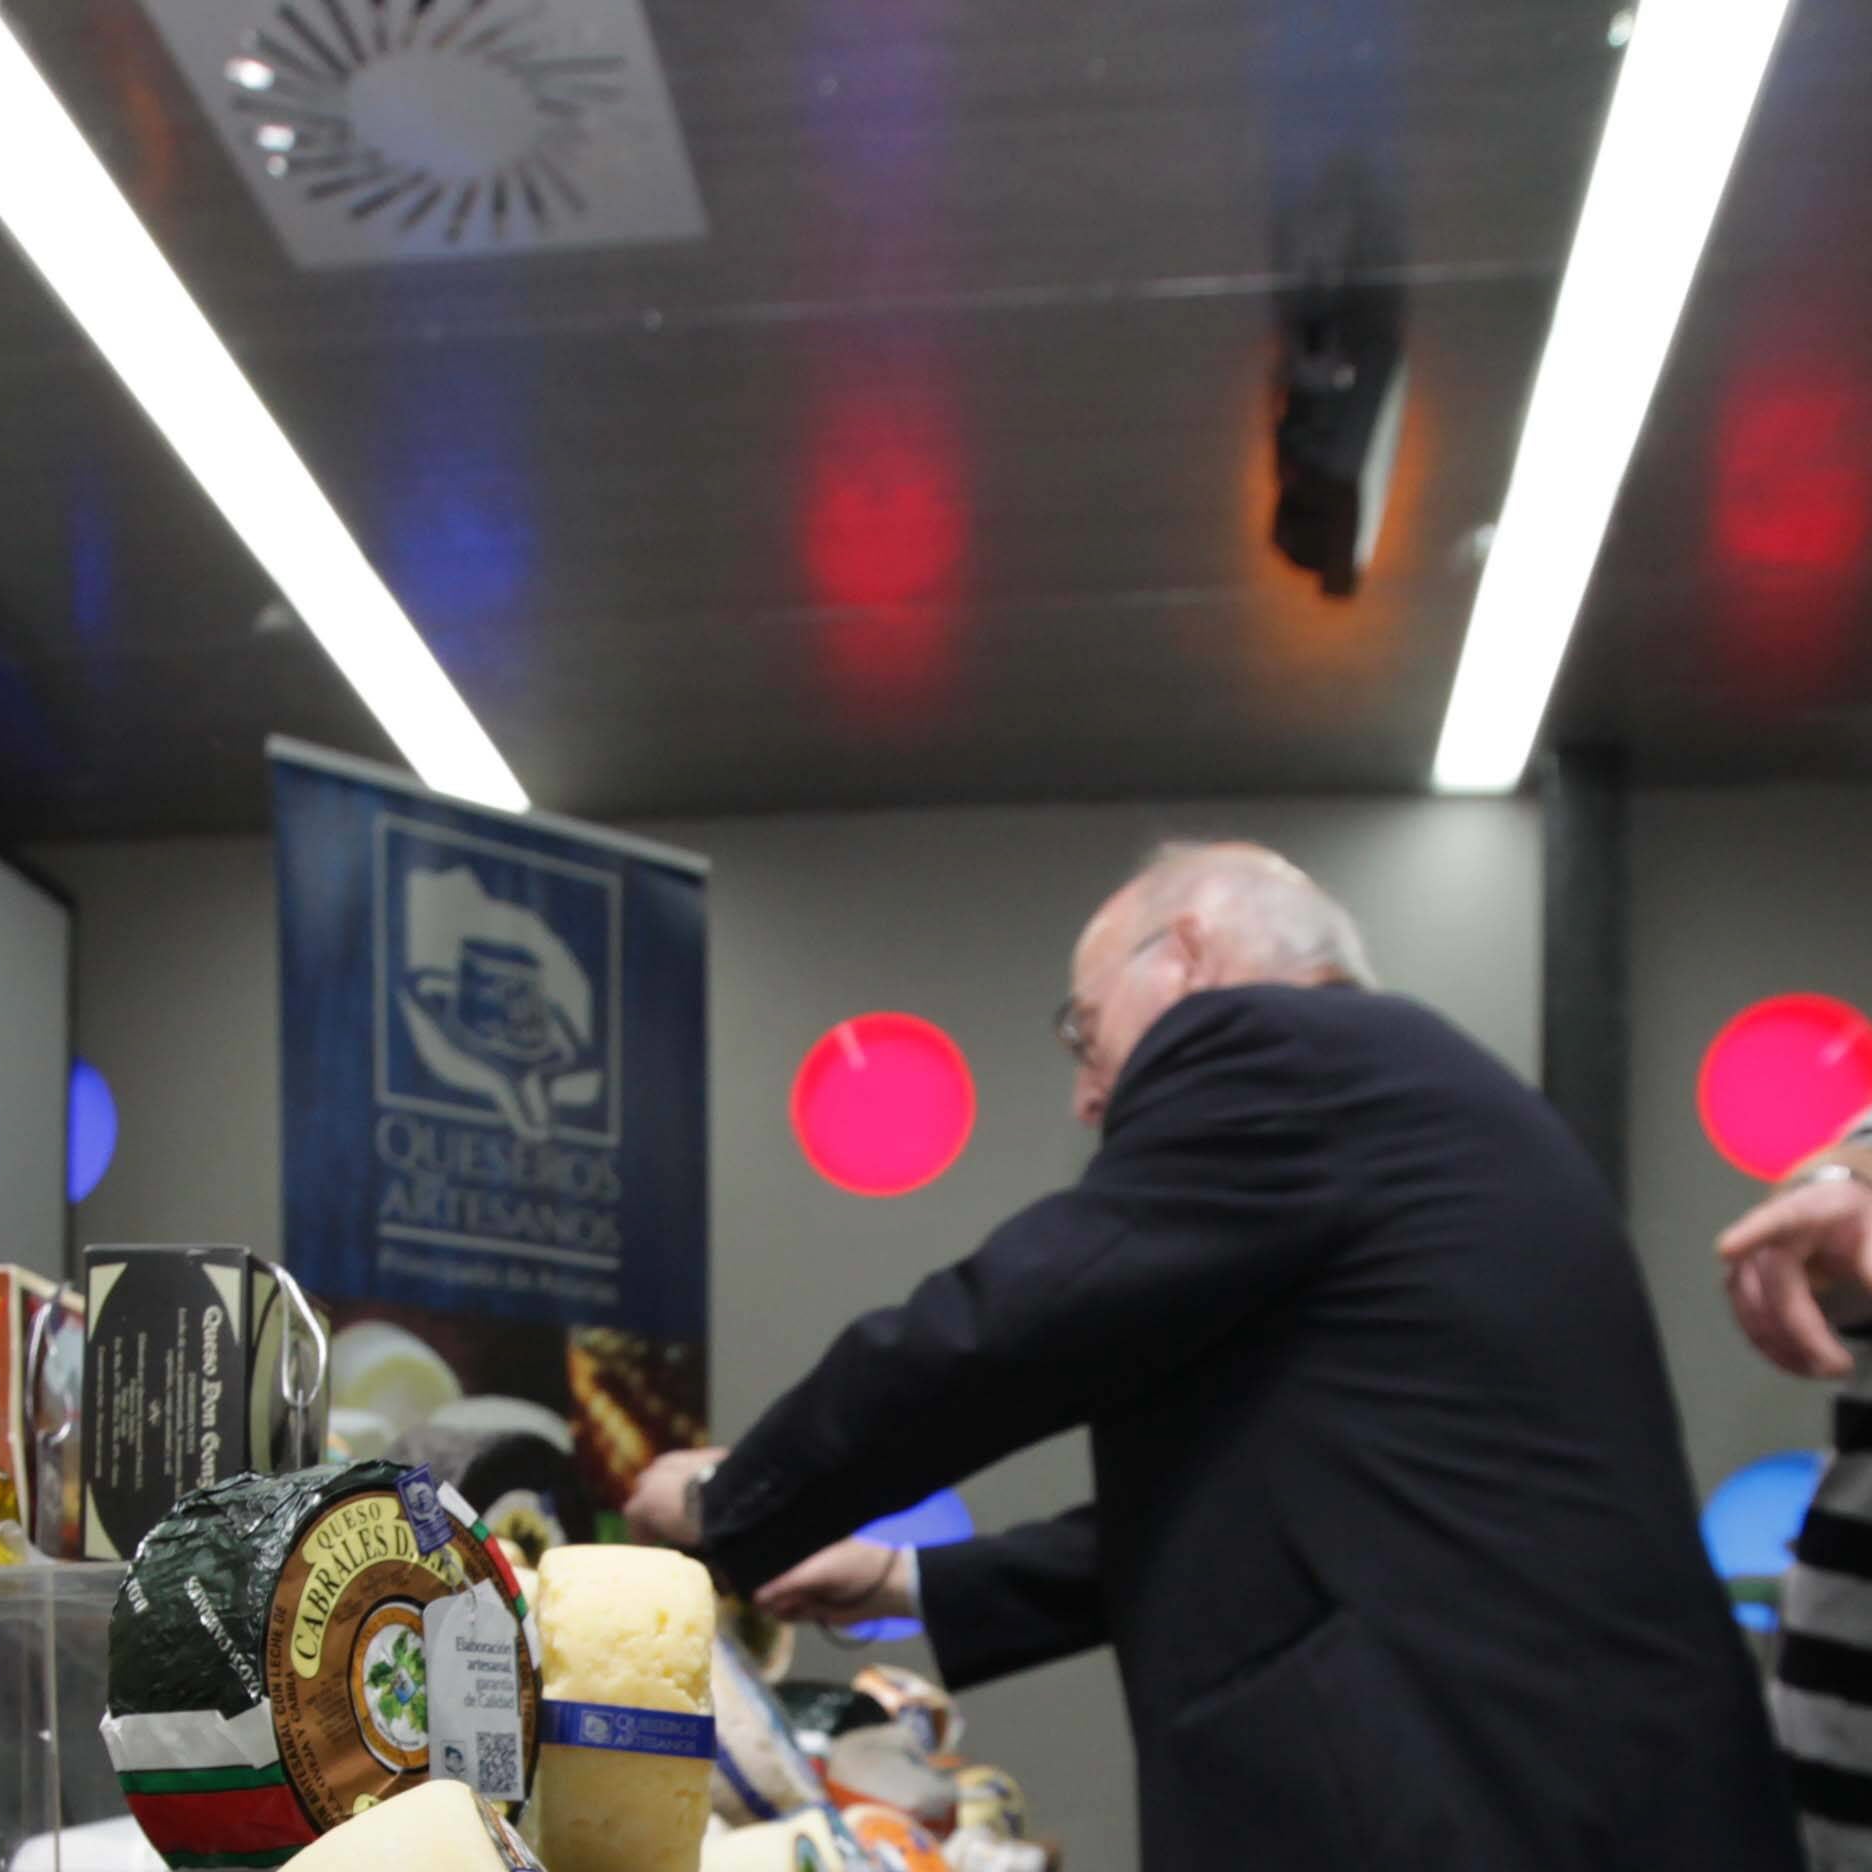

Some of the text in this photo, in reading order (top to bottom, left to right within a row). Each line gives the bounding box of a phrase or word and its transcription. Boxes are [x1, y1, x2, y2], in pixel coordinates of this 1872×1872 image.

[195, 1304, 223, 1490] Queso Don Gonz
[316, 1502, 382, 1551] QUESO
[295, 1523, 389, 1662] CABRALES
[270, 1631, 284, 1680] LECHE
[455, 1636, 512, 1655] Elaboración
[271, 1682, 285, 1717] CON
